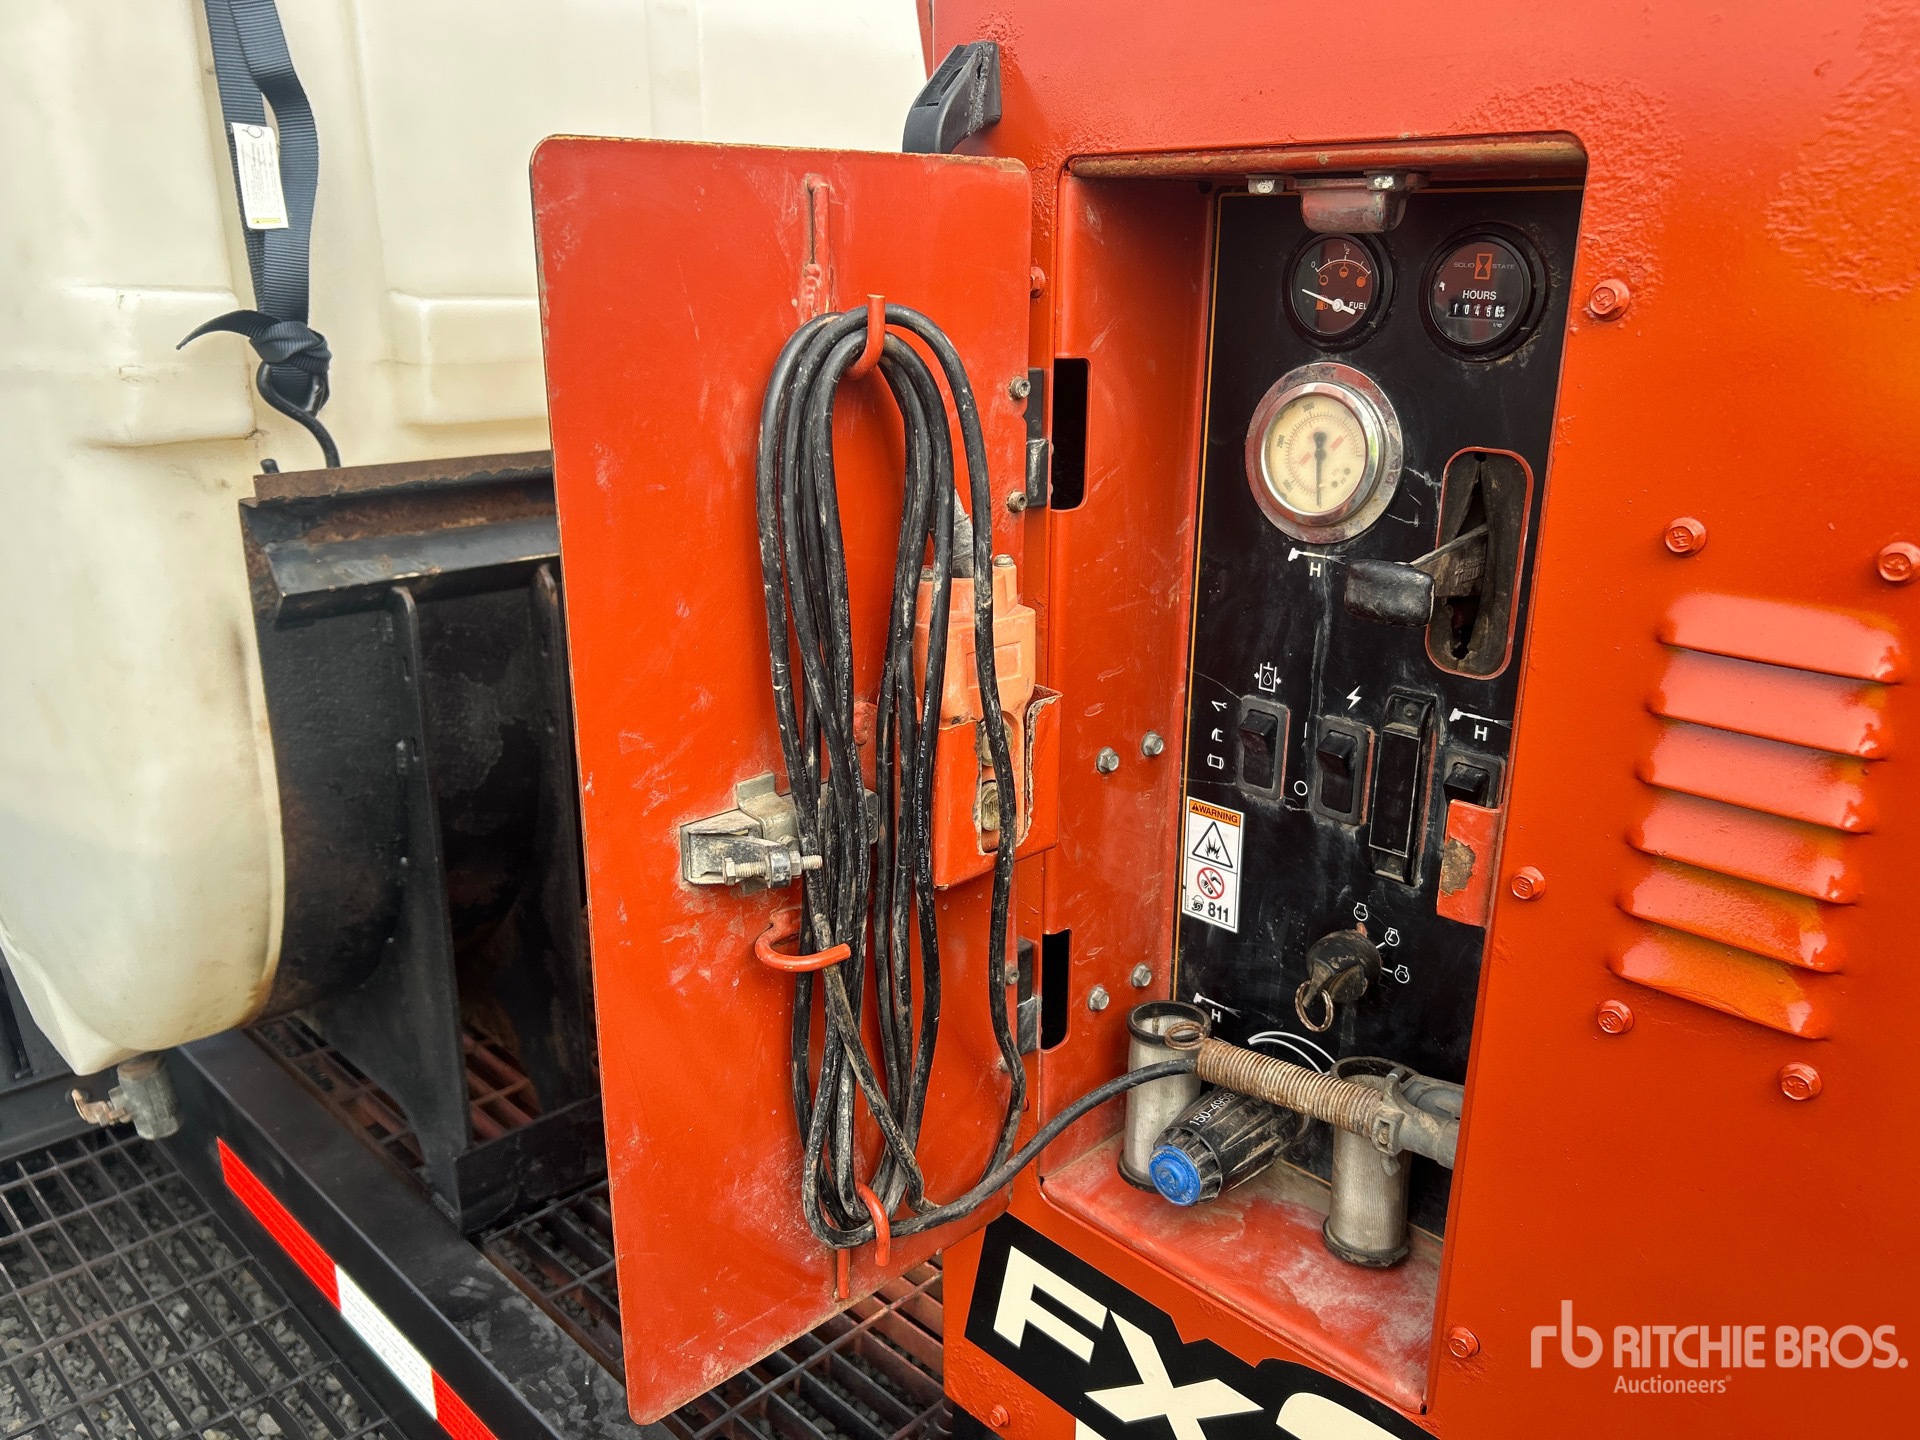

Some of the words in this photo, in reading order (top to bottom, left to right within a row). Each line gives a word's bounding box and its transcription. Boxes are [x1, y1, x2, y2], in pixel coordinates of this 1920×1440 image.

[1453, 261, 1475, 269] SOLID
[1462, 289, 1497, 301] HOURS
[1348, 301, 1367, 310] FUEL
[1309, 561, 1322, 578] H
[1473, 724, 1488, 742] H
[1198, 804, 1239, 825] WARNING
[1207, 901, 1229, 923] 811
[1211, 1008, 1223, 1024] H
